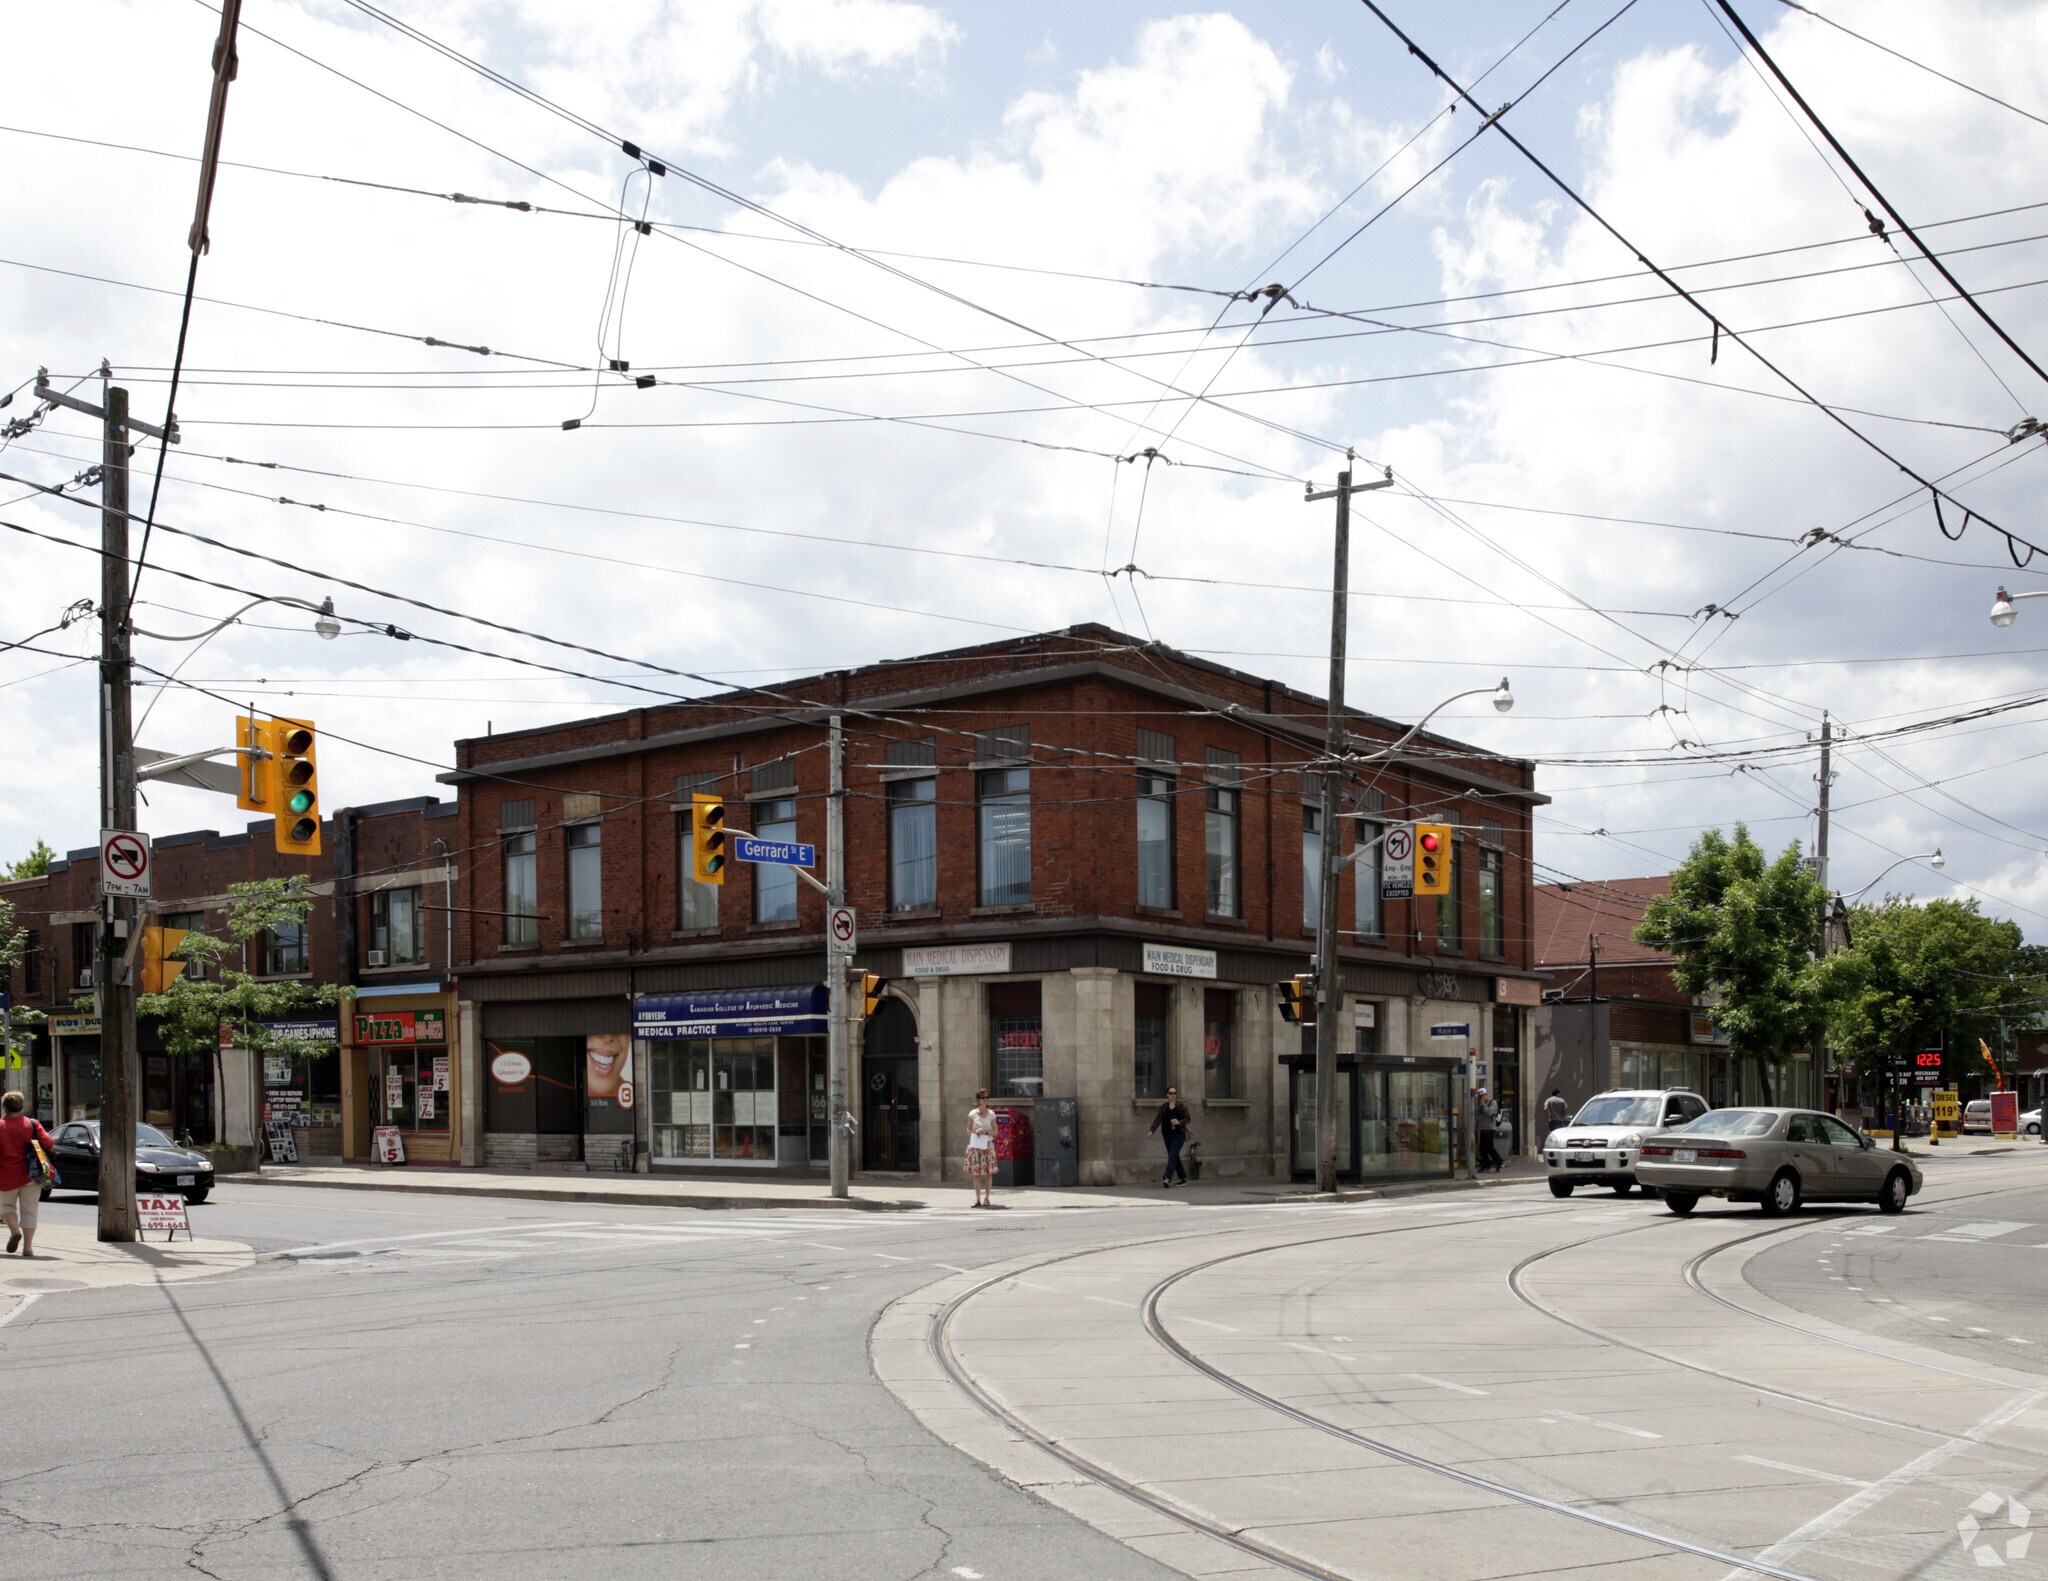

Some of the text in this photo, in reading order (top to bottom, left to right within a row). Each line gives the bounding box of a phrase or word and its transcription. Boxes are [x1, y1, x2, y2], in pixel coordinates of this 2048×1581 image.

[744, 840, 806, 861] Gerrard St E
[105, 881, 122, 892] 7PM
[132, 883, 149, 894] 7AM
[1386, 889, 1410, 897] EXCEPTED
[906, 944, 1008, 966] MAIN MEDICAL DISPENSARY
[1146, 949, 1215, 968] MAIN MEDICAL DISPENSARY
[1151, 962, 1169, 972] FOOD
[1170, 964, 1175, 972] &
[1175, 965, 1193, 974] DRUG
[690, 1004, 715, 1013] CANADIAN
[715, 1003, 737, 1012] COLLEGE
[745, 1001, 774, 1010] AYURVEDIC
[774, 999, 799, 1009] MEDICINE
[638, 1011, 667, 1021] AYURVEDIC
[355, 1015, 403, 1042] Pizza
[638, 1024, 717, 1037] MEDICAL PRACTICE
[811, 1095, 827, 1108] 166
[1936, 1093, 1956, 1102] DIESEL
[137, 1199, 182, 1210] TAX
